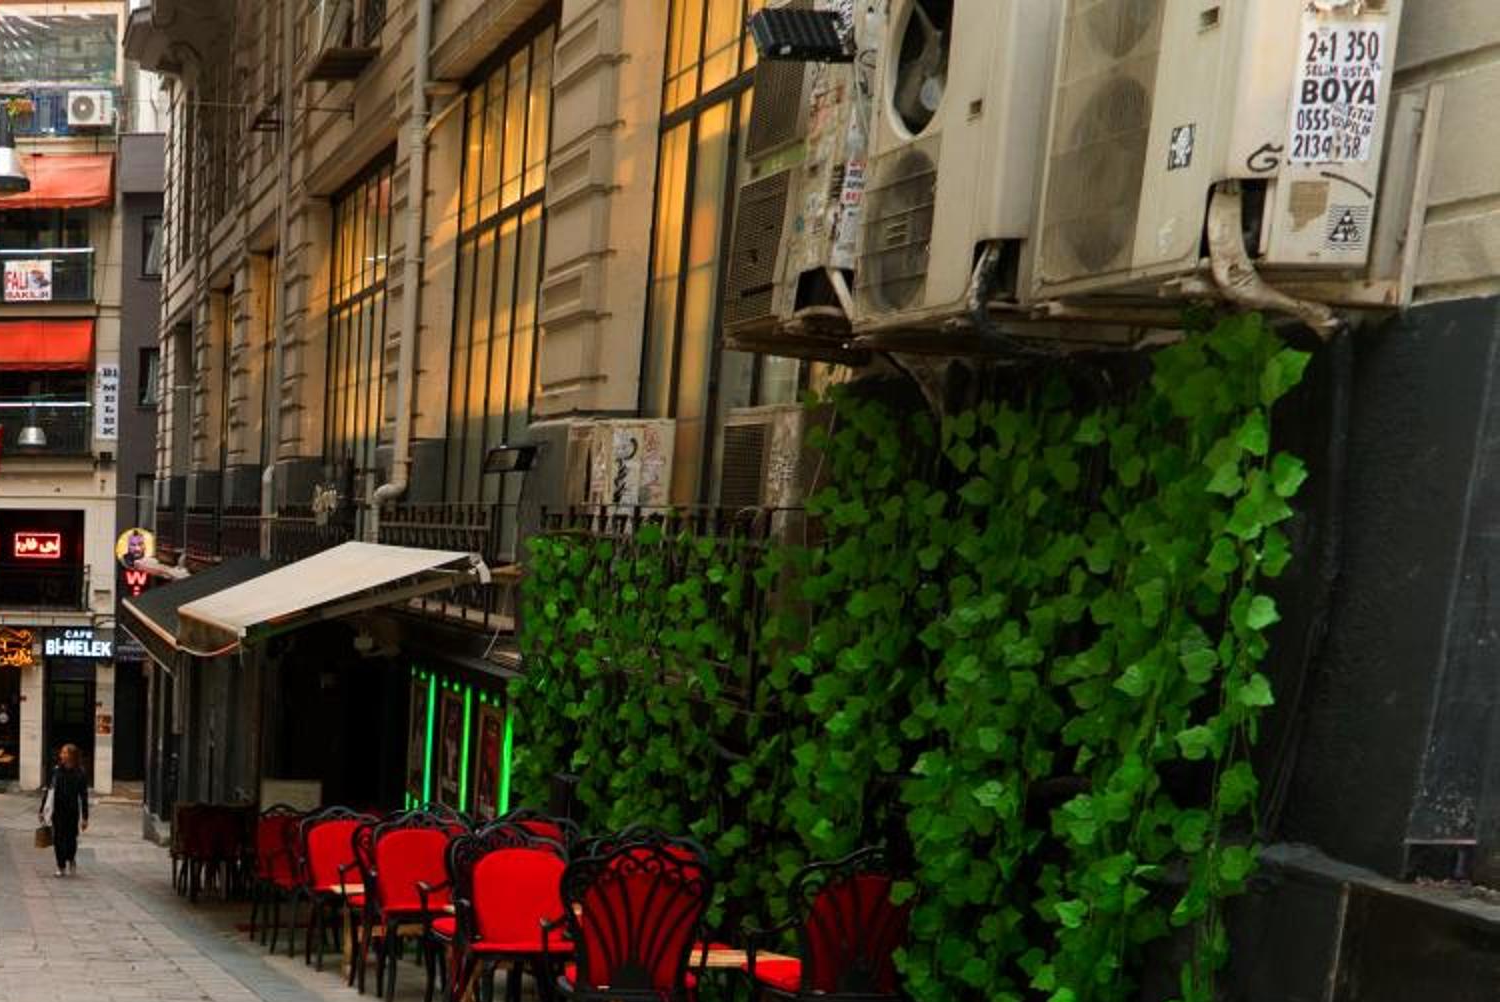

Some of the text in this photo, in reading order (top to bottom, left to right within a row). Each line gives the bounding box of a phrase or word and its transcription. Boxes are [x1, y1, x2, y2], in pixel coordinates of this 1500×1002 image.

[1306, 31, 1336, 62] 2+1
[1345, 30, 1379, 62] 350
[1301, 78, 1375, 104] BOYA
[1297, 108, 1329, 130] 0555
